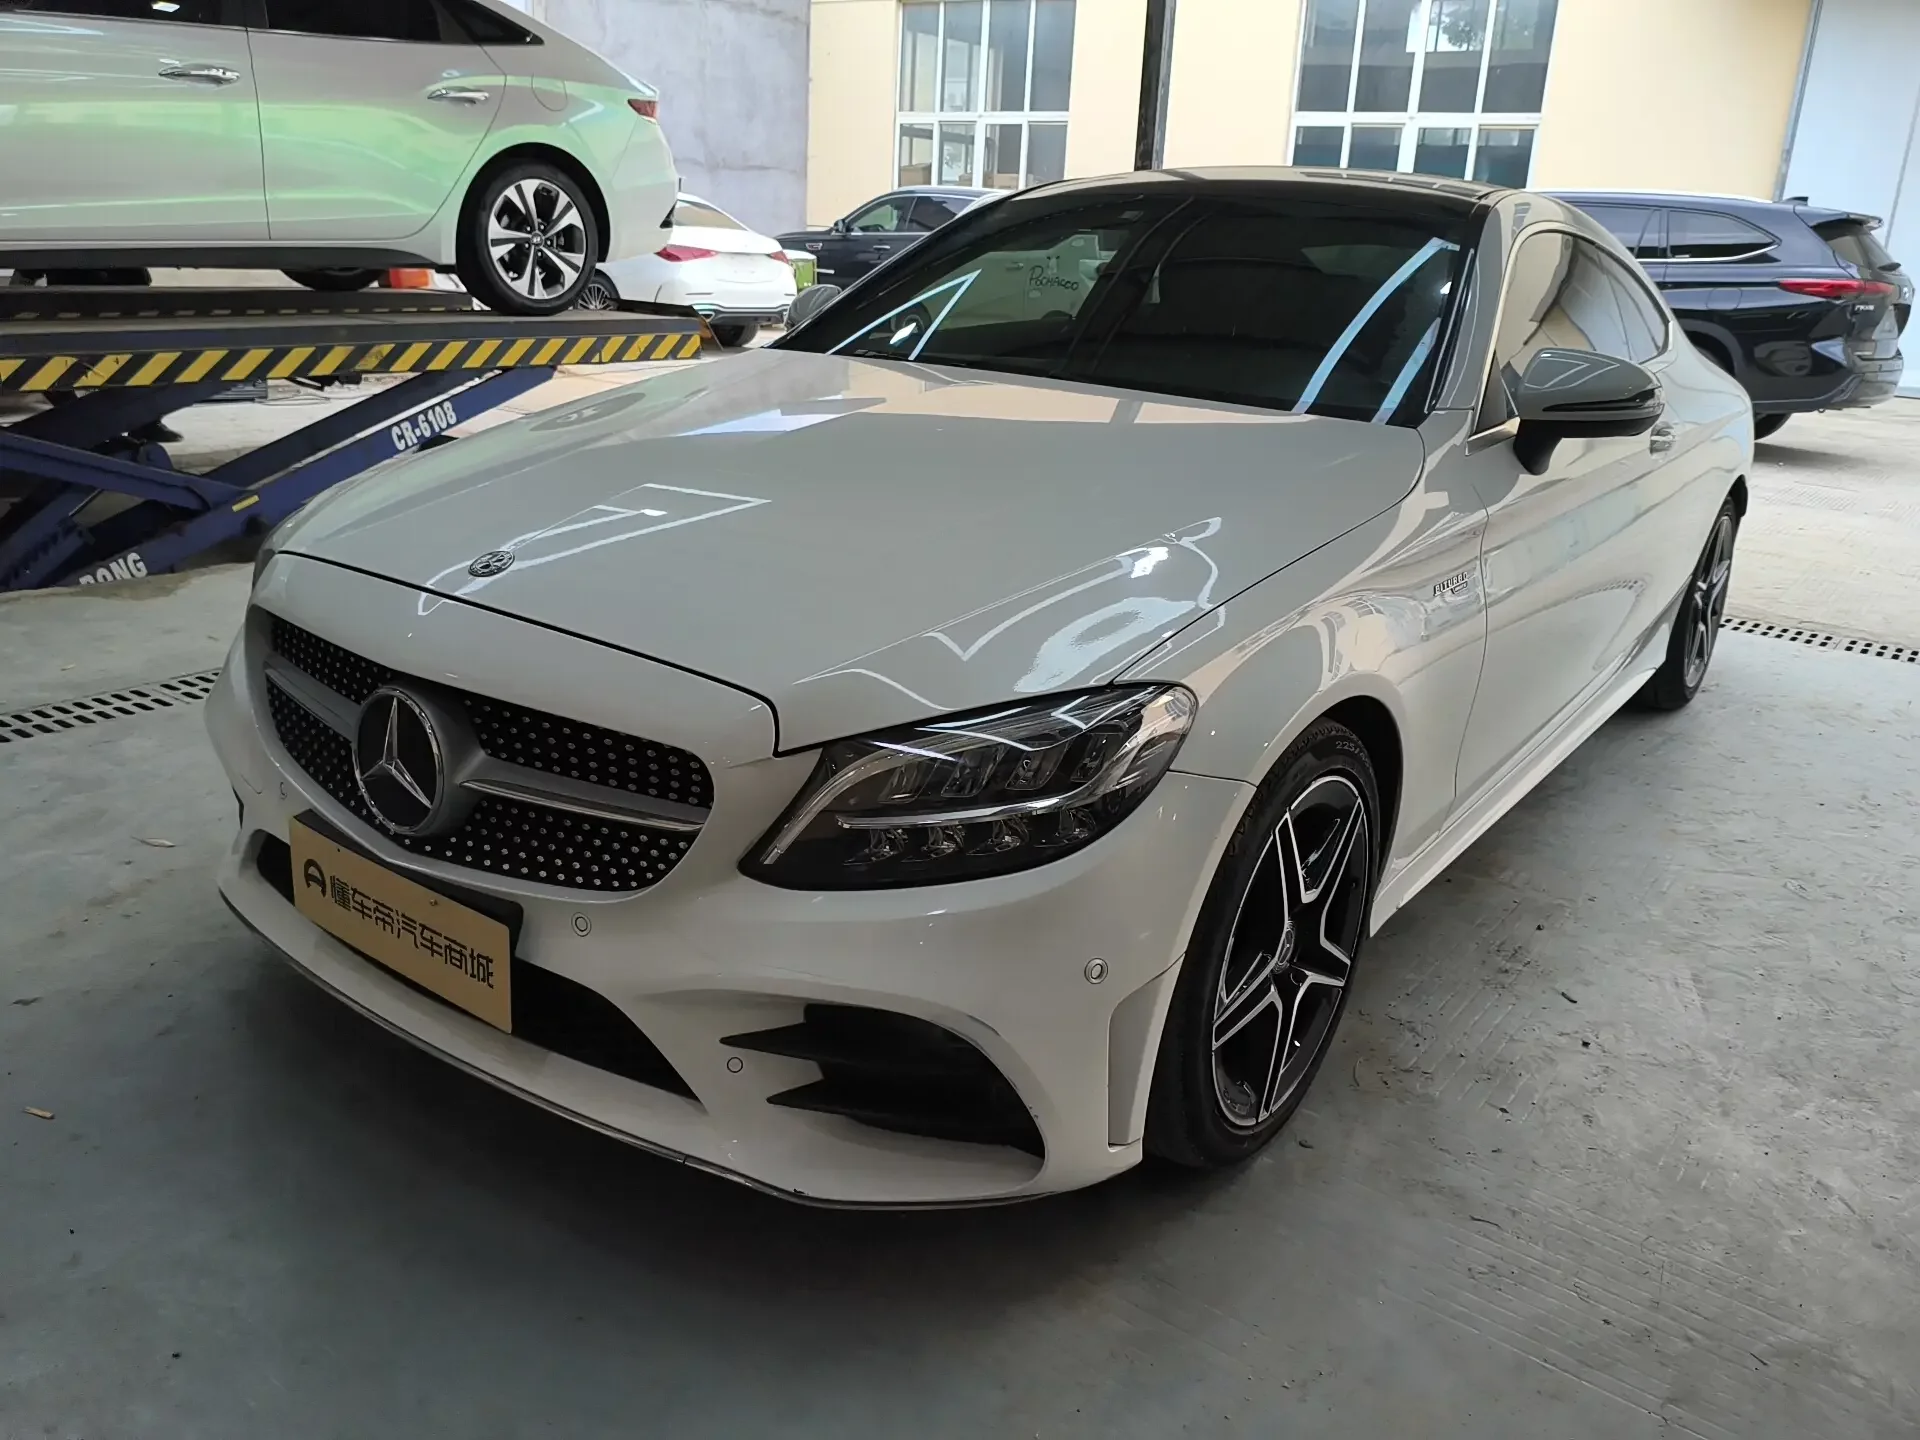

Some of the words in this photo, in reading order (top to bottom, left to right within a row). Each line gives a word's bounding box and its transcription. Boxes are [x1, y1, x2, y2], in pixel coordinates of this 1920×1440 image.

[391, 400, 457, 451] CR-6108
[1433, 571, 1468, 597] BITURBO
[329, 875, 494, 989] 懂车帝汽车商城
